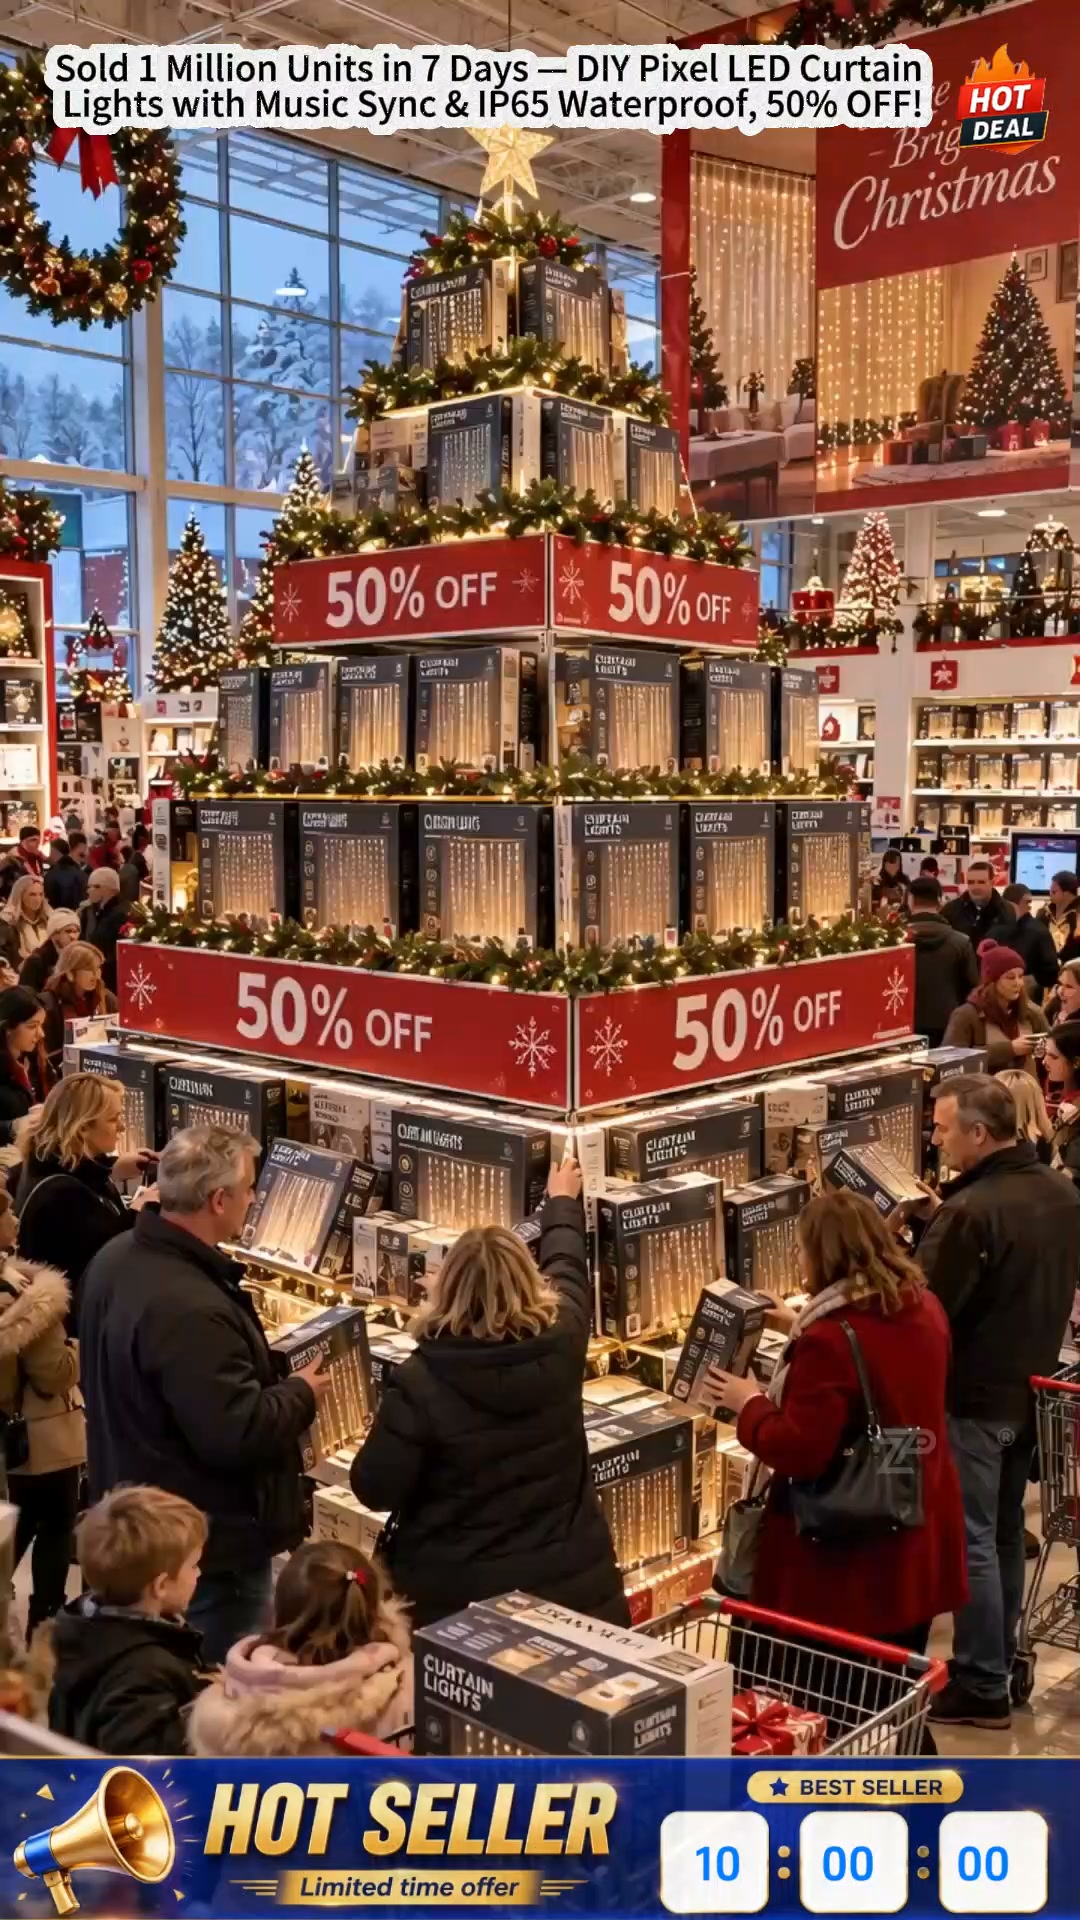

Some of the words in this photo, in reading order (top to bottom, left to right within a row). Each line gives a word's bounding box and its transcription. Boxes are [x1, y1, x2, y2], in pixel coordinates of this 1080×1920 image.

[834, 155, 1061, 250] Christmas
[325, 563, 425, 628] 50%
[435, 572, 498, 609] OFF
[608, 560, 691, 625] 50%
[696, 591, 732, 625] OFF
[235, 971, 353, 1050] 50%
[365, 1008, 433, 1053] OFF
[672, 984, 784, 1072] 50%
[793, 990, 843, 1033] OFF
[423, 1653, 494, 1699] CURTAIN
[423, 1671, 482, 1712] LIGHTS
